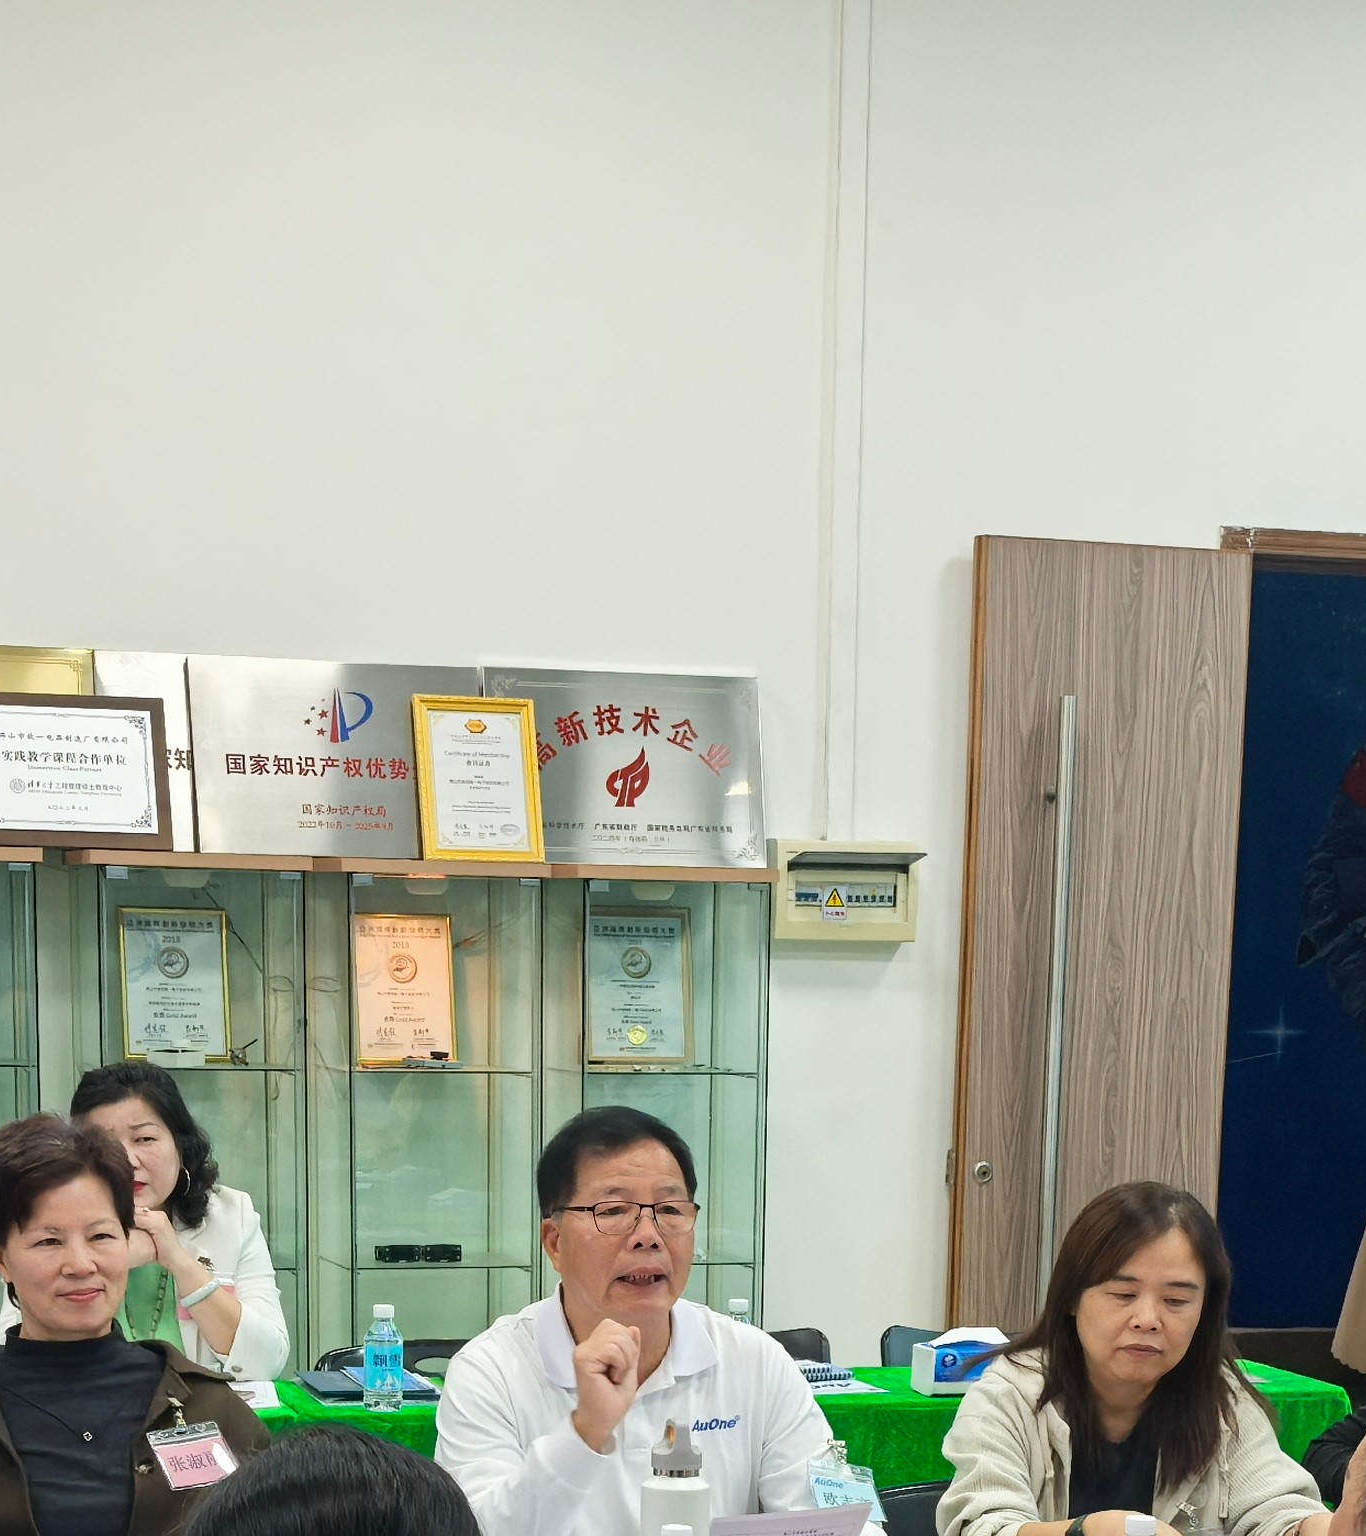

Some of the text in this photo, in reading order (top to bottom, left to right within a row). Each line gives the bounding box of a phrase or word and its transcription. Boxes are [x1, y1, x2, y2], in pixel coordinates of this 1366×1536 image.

[536, 703, 732, 777] 高新技术企业
[1, 750, 127, 766] 实践教学课程合作单位
[225, 753, 417, 780] 国家知识产权优势
[302, 804, 387, 817] 国家知识产权局
[691, 1416, 736, 1433] AuOne
